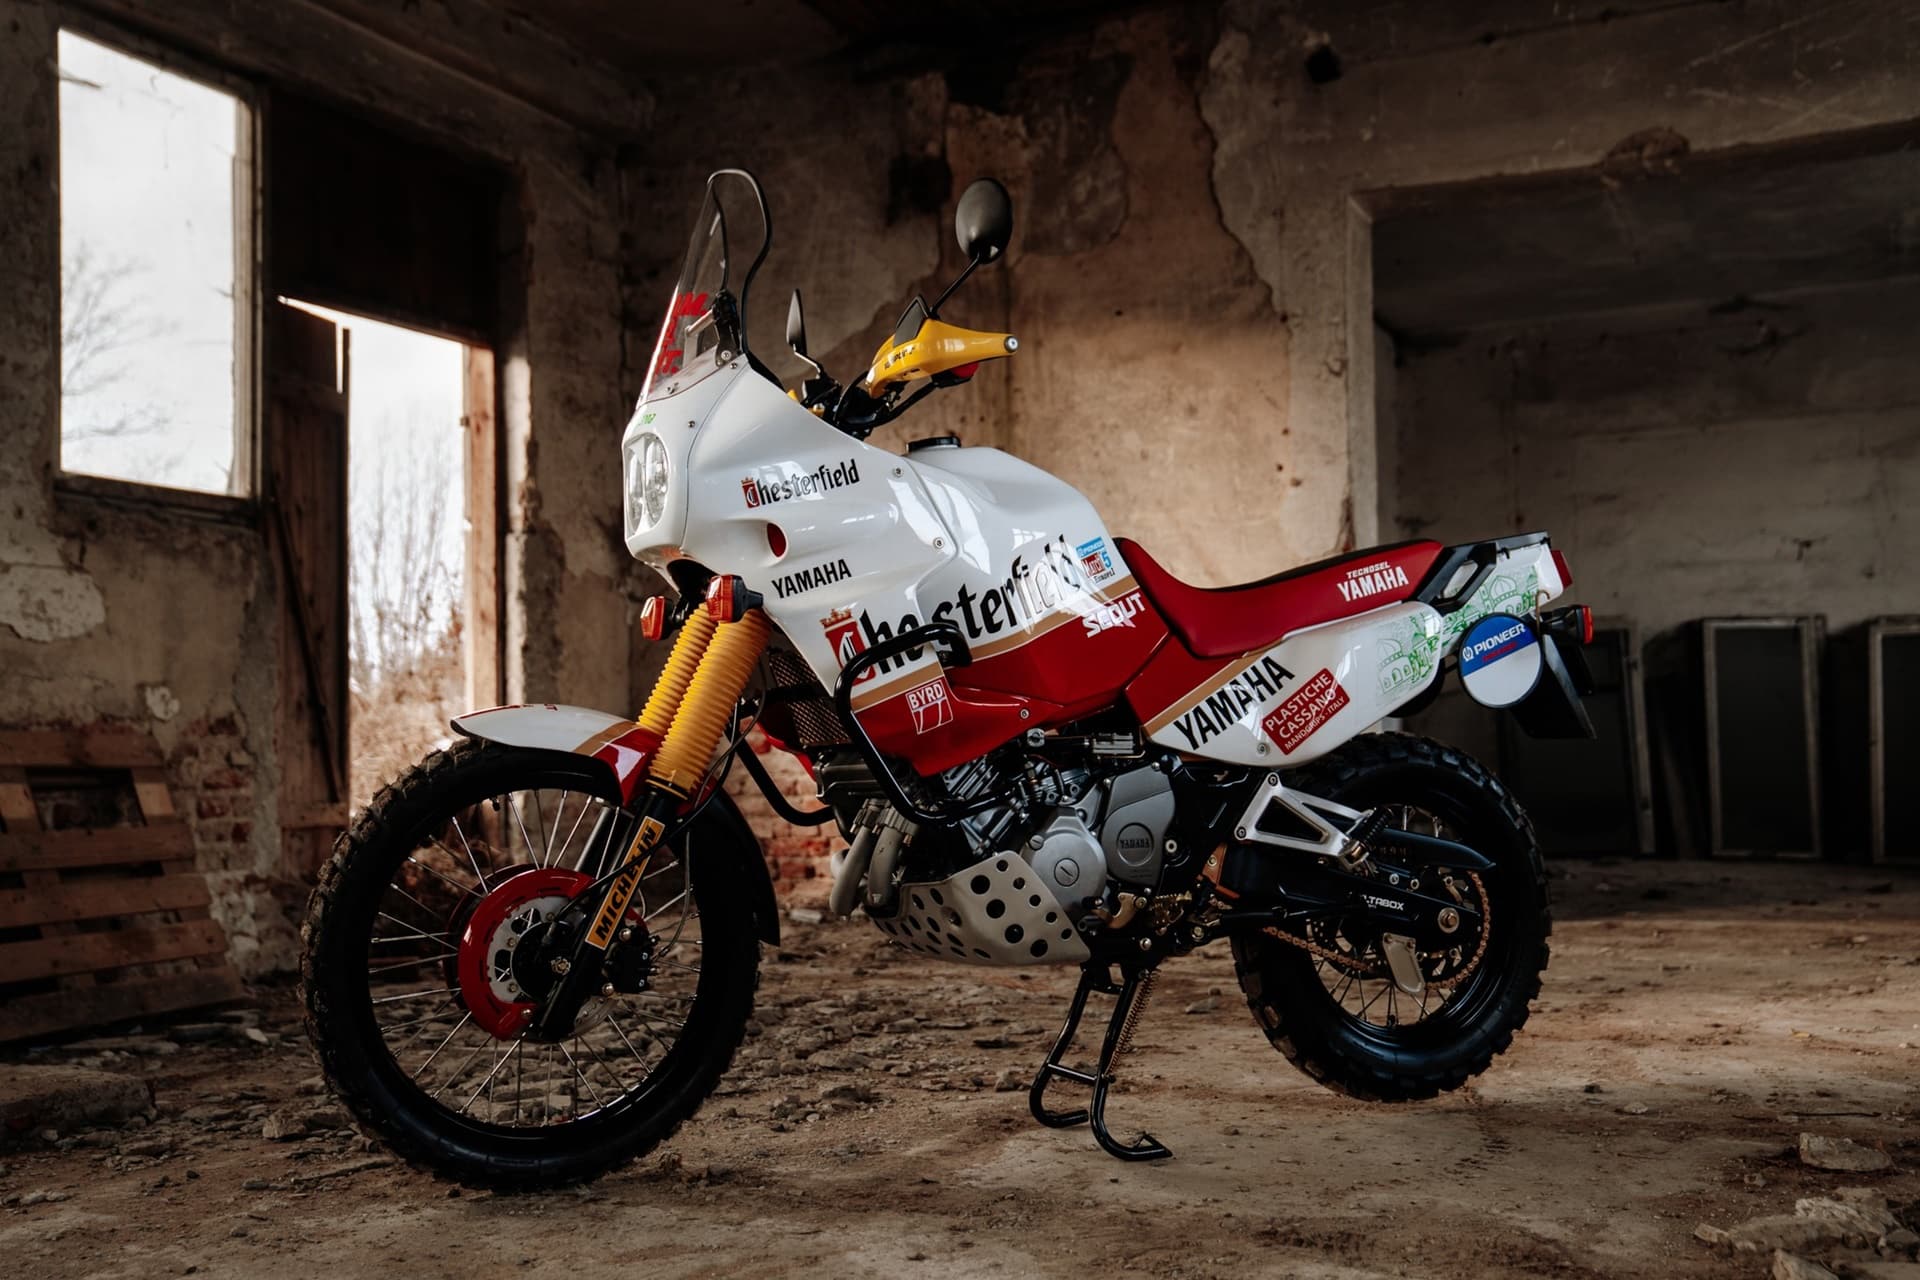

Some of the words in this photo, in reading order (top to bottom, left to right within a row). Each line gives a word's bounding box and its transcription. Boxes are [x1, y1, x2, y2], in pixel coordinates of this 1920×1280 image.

[741, 459, 860, 509] Chesterfield
[771, 558, 852, 599] YAMAHA
[1337, 566, 1409, 602] YAMAHA
[1473, 623, 1526, 655] PIONEER
[908, 683, 943, 709] BYRD
[1173, 656, 1295, 751] YAMAHA
[1265, 673, 1332, 732] PLASTICHE
[1279, 688, 1337, 739] CASSANO
[1327, 697, 1346, 714] ITALY
[595, 826, 657, 941] MICHEIN
